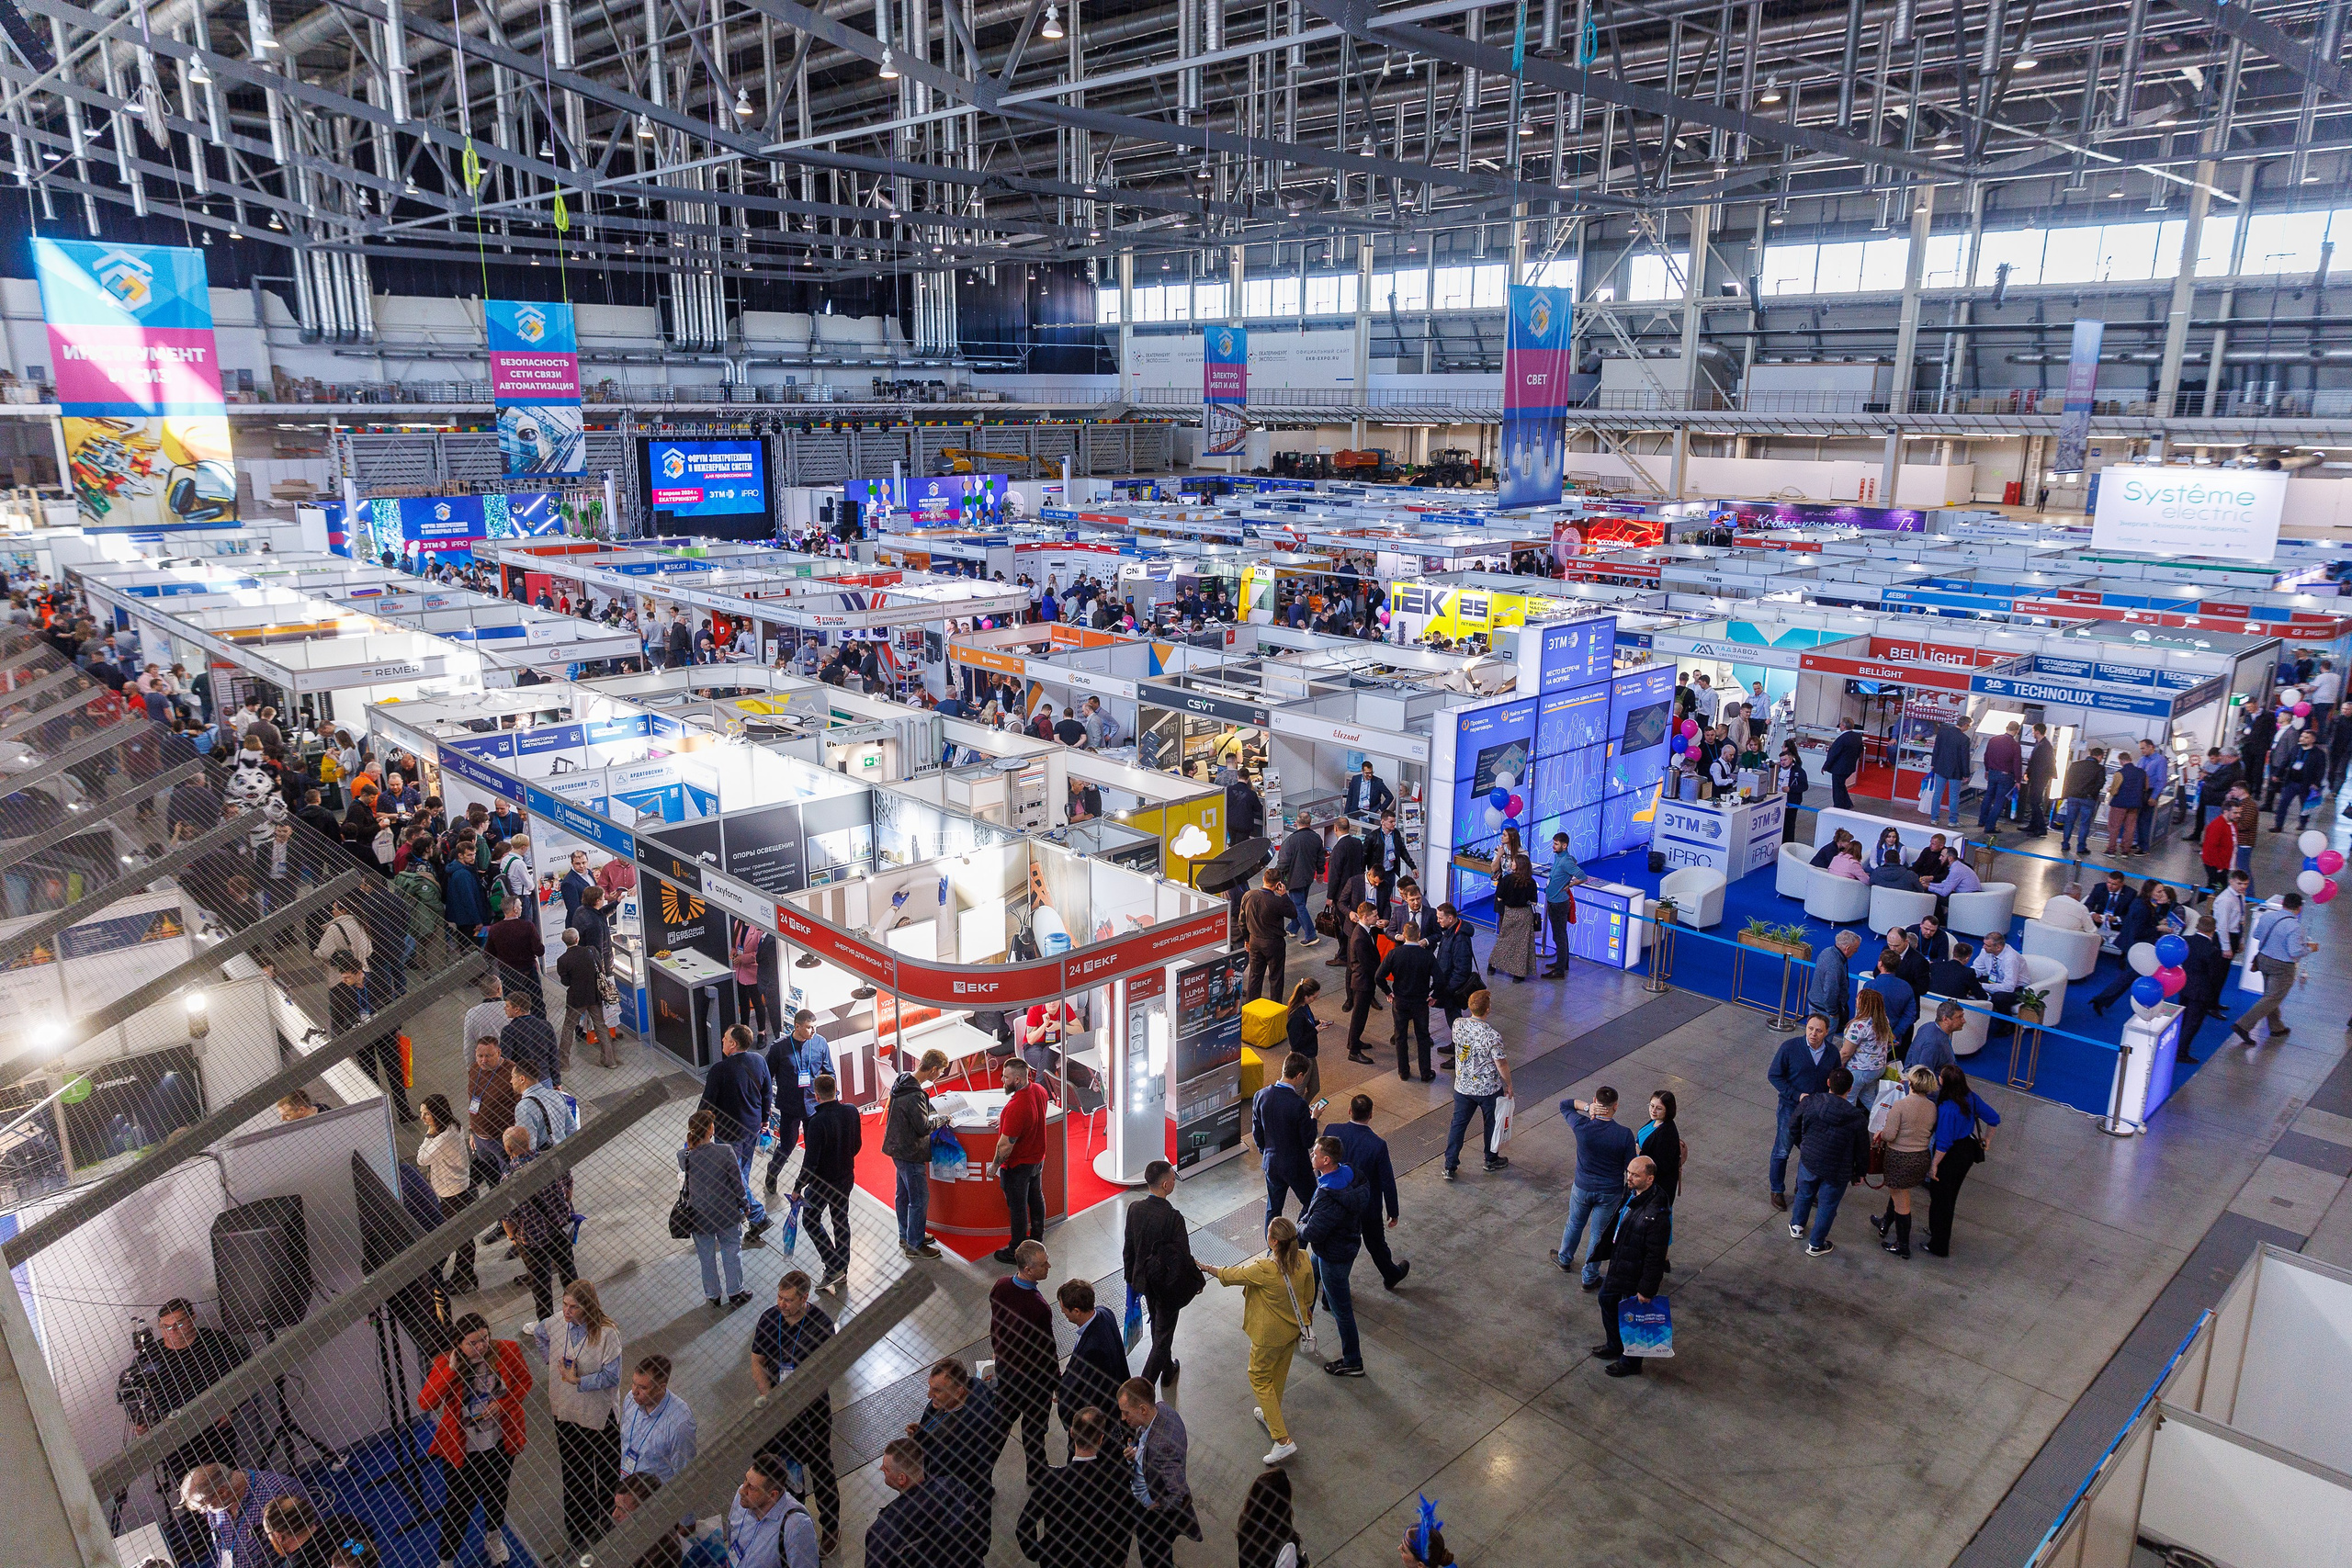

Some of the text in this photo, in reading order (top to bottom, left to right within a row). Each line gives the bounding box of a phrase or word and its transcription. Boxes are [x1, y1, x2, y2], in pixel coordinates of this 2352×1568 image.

[62, 344, 207, 363] ИНСТРУМЕНТ
[500, 358, 570, 367] БЕЗОПАСНОСТЬ
[129, 368, 173, 384] СИЗ
[510, 370, 562, 378] СЕТИ СВЯЗИ
[1212, 371, 1238, 380] ЭЛЕКТРО
[1526, 374, 1548, 386] СВЕТ
[499, 381, 574, 391] АВТОМАТИЗАЦИЯ
[1210, 381, 1240, 390] ИБП И АКБ
[687, 453, 752, 463] ФОРУМ ЭЛЕКТРОТЕХНИКИ
[688, 463, 693, 472] И
[731, 462, 753, 471] СИСТЕМ
[709, 491, 726, 499] ЭТМ
[2123, 480, 2256, 506] Systême
[2162, 505, 2254, 523] electric
[1886, 592, 1907, 600] ДЕВИ
[380, 604, 404, 612] ВЕСПЕР
[1459, 598, 1488, 618] 25
[1548, 636, 1568, 650] ЭТМ
[2037, 657, 2090, 670] СВЕТОДИОДНОЕ
[2041, 665, 2083, 675] ОСВЕЩЕНИЕ
[375, 664, 420, 677] REMER
[1546, 664, 1580, 678] МЕСТО ВСТРЕЧИ
[2098, 664, 2153, 678] TECHNOLUX
[1552, 674, 1570, 684] ФОРУМЕ
[2012, 682, 2095, 705] TECHNOLUX
[2098, 694, 2155, 706] профессиональное
[1187, 699, 1216, 713] CSVT
[1470, 717, 1489, 727] Провести
[1509, 716, 1525, 724] импорту
[1163, 722, 1179, 735] IP67
[1470, 724, 1493, 733] переговоры
[521, 735, 559, 744] ПРОЖЕКТОРНЫЕ
[521, 739, 555, 749] СВЕТИЛЬНИКИ
[1163, 752, 1179, 765] IP65
[469, 767, 503, 790] ТЕХНОЛОГИИ СВЕТА
[629, 767, 675, 779] АРДАТОВСКИЙ 75
[551, 780, 600, 792] АРДАТОВСКИЙ 75
[528, 795, 535, 803] 22
[565, 808, 602, 839] АРДАТОВСКИЙ 75
[1664, 813, 1700, 833] ЭТМ
[1751, 812, 1771, 831] ЭТМ
[639, 848, 645, 858] 23
[732, 840, 795, 860] ОПОРЫ ОСВЕЩЕНИЯ
[1751, 841, 1775, 864] iPRO
[1668, 847, 1712, 867] iPRO
[733, 861, 775, 874] Опоры: граненые
[752, 863, 796, 876] круглоконические
[752, 869, 796, 884] складывающиеся
[715, 883, 742, 904] axyforma
[780, 913, 811, 935] 24 EKF
[676, 926, 705, 937] СДЕЛАНО
[1152, 926, 1213, 949] ЭНЕРГИЯ ДЛЯ ЖИЗНИ
[834, 942, 883, 968] ЭНЕРГИЯ ДЛЯ ЖИЗНИ
[1069, 953, 1118, 976] 24 EKF
[1136, 978, 1152, 987] EKF
[1191, 974, 1205, 984] EKF
[967, 983, 1000, 993] EKF
[1184, 987, 1205, 998] LUMA
[95, 1075, 138, 1091] УЛИЦА
